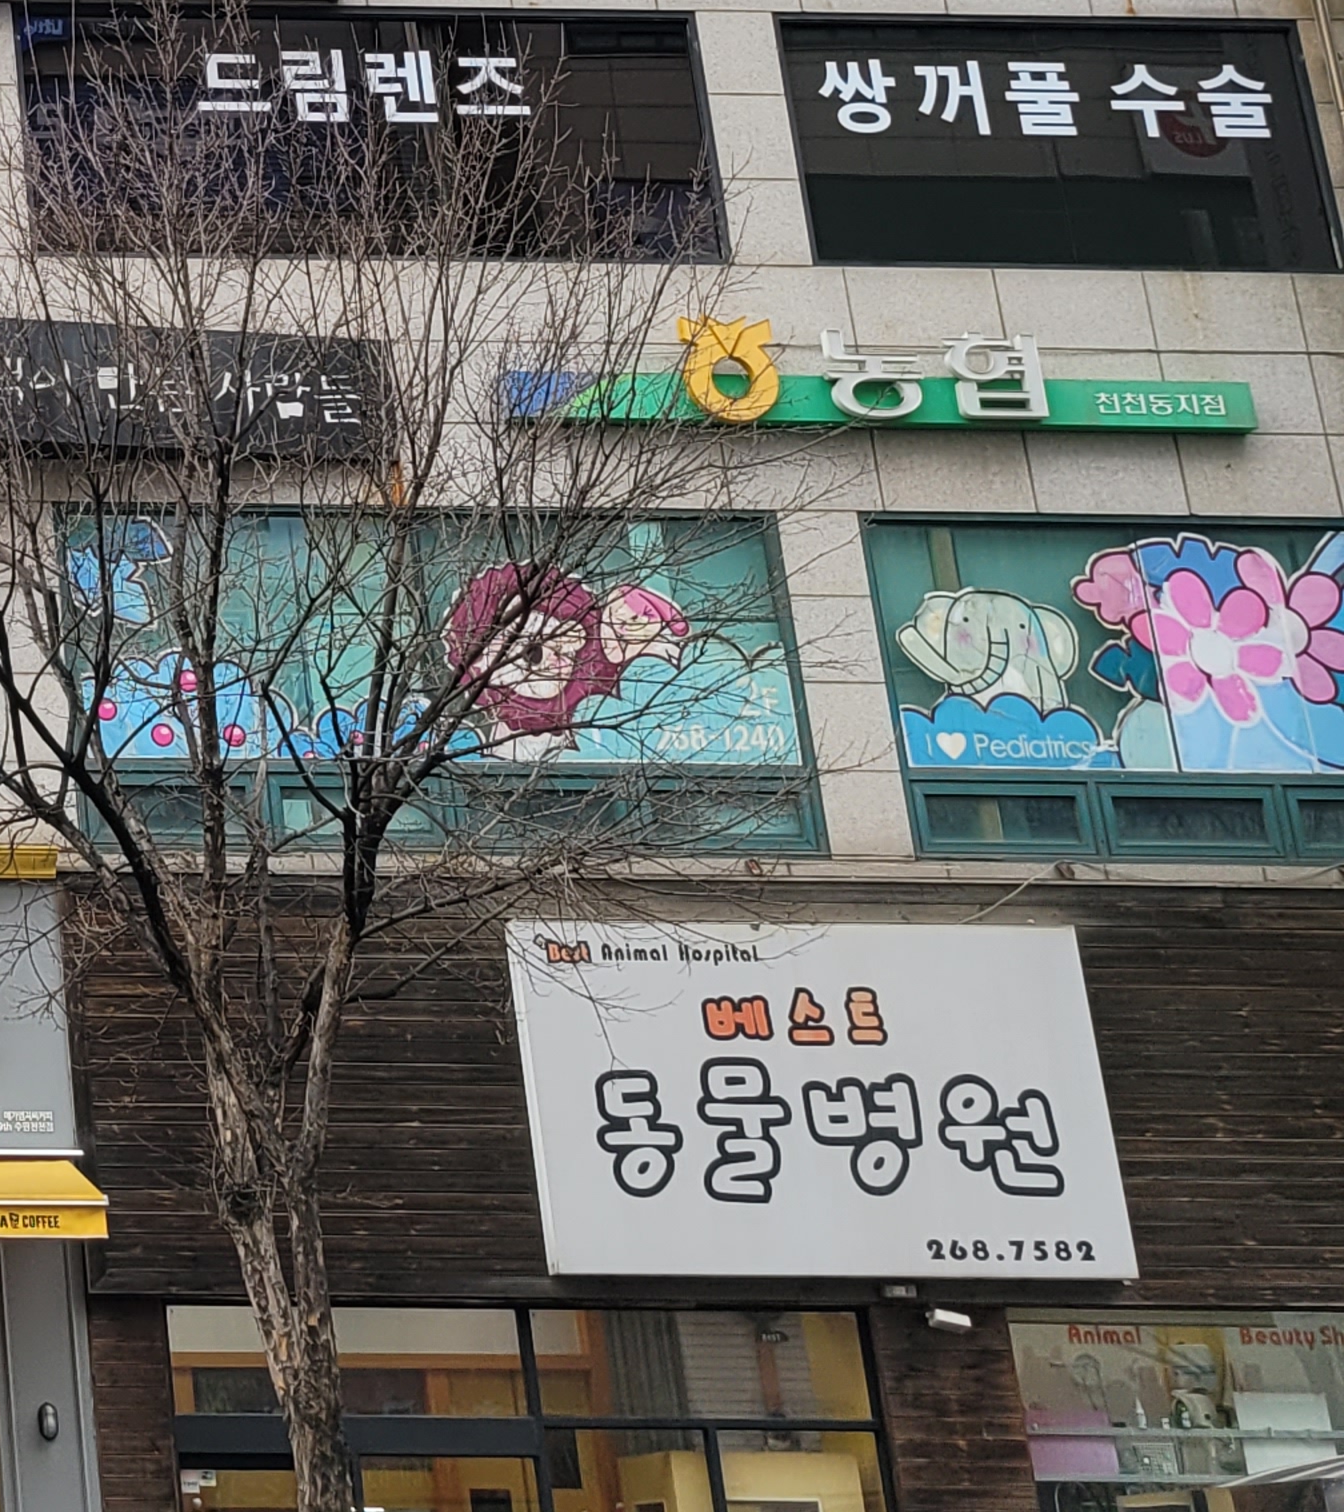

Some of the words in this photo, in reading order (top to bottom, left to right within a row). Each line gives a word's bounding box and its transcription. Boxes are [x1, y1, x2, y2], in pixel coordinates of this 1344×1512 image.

[196, 48, 534, 126] 드림렌즈
[814, 54, 1084, 140] 쌍꺼풀
[1108, 59, 1276, 143] 수술
[819, 327, 1052, 424] 농협
[1093, 389, 1227, 419] 천천동지점
[972, 730, 1094, 762] Pediatrics
[600, 943, 668, 963] Animal
[678, 943, 760, 966] Hospital
[701, 985, 890, 1048] 베스트
[594, 1054, 1067, 1205] 동물병원
[22, 1214, 61, 1229] COFFEE
[925, 1238, 1099, 1264] 268.7582
[1067, 1323, 1142, 1346] Animal
[1239, 1325, 1317, 1350] Beauty
